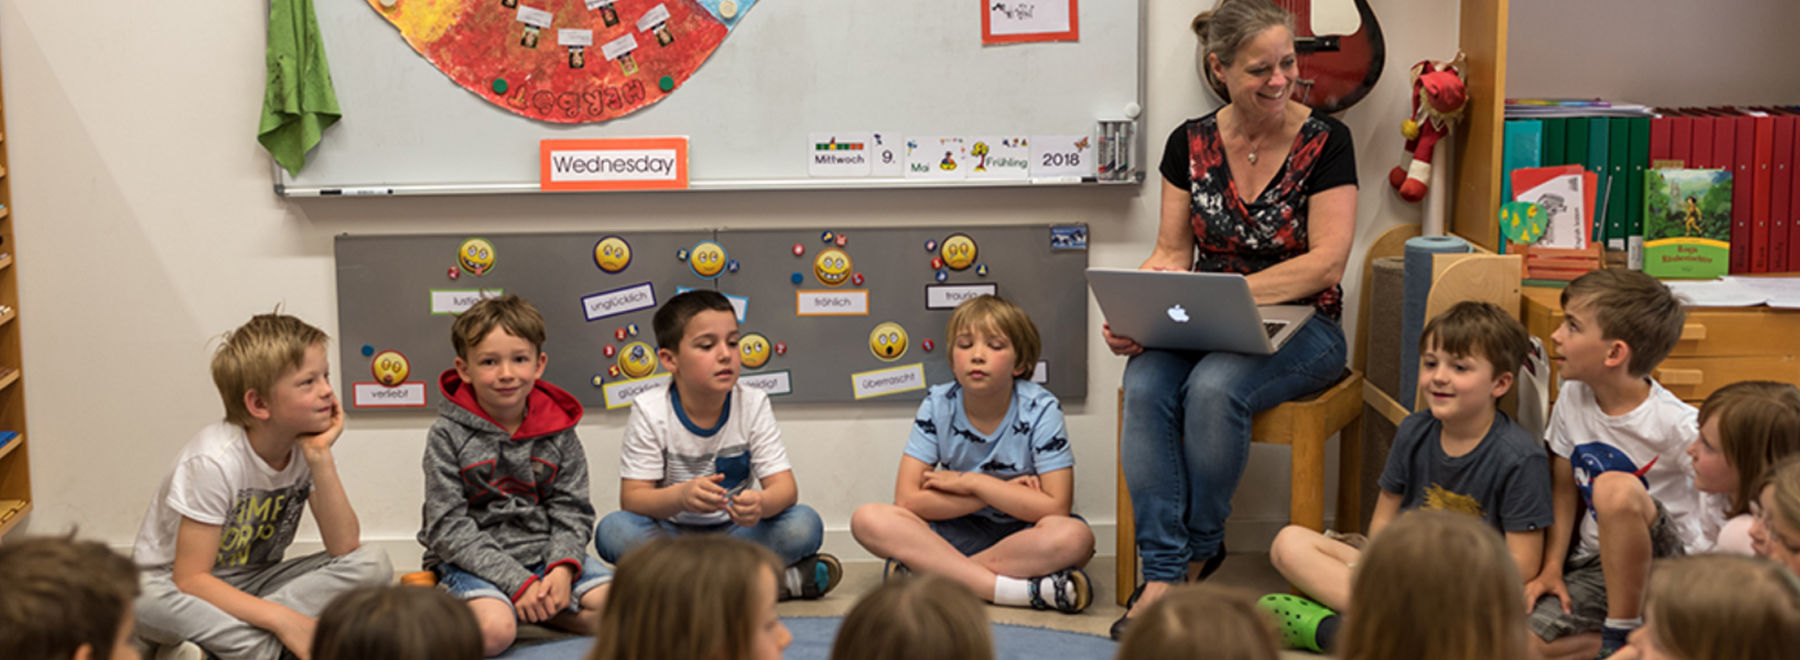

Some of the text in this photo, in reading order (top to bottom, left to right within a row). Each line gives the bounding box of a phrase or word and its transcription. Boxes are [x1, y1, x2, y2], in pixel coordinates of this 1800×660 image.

[814, 154, 865, 165] Mittwoch
[881, 150, 896, 164] 9.
[986, 155, 1028, 169] Frühling
[1042, 153, 1080, 166] 2018
[552, 154, 675, 176] Wednesday
[911, 163, 930, 173] Mai
[590, 291, 648, 312] unglücklich
[814, 295, 853, 308] fröhlich
[861, 372, 917, 390] überrascht
[370, 387, 410, 400] verliebt
